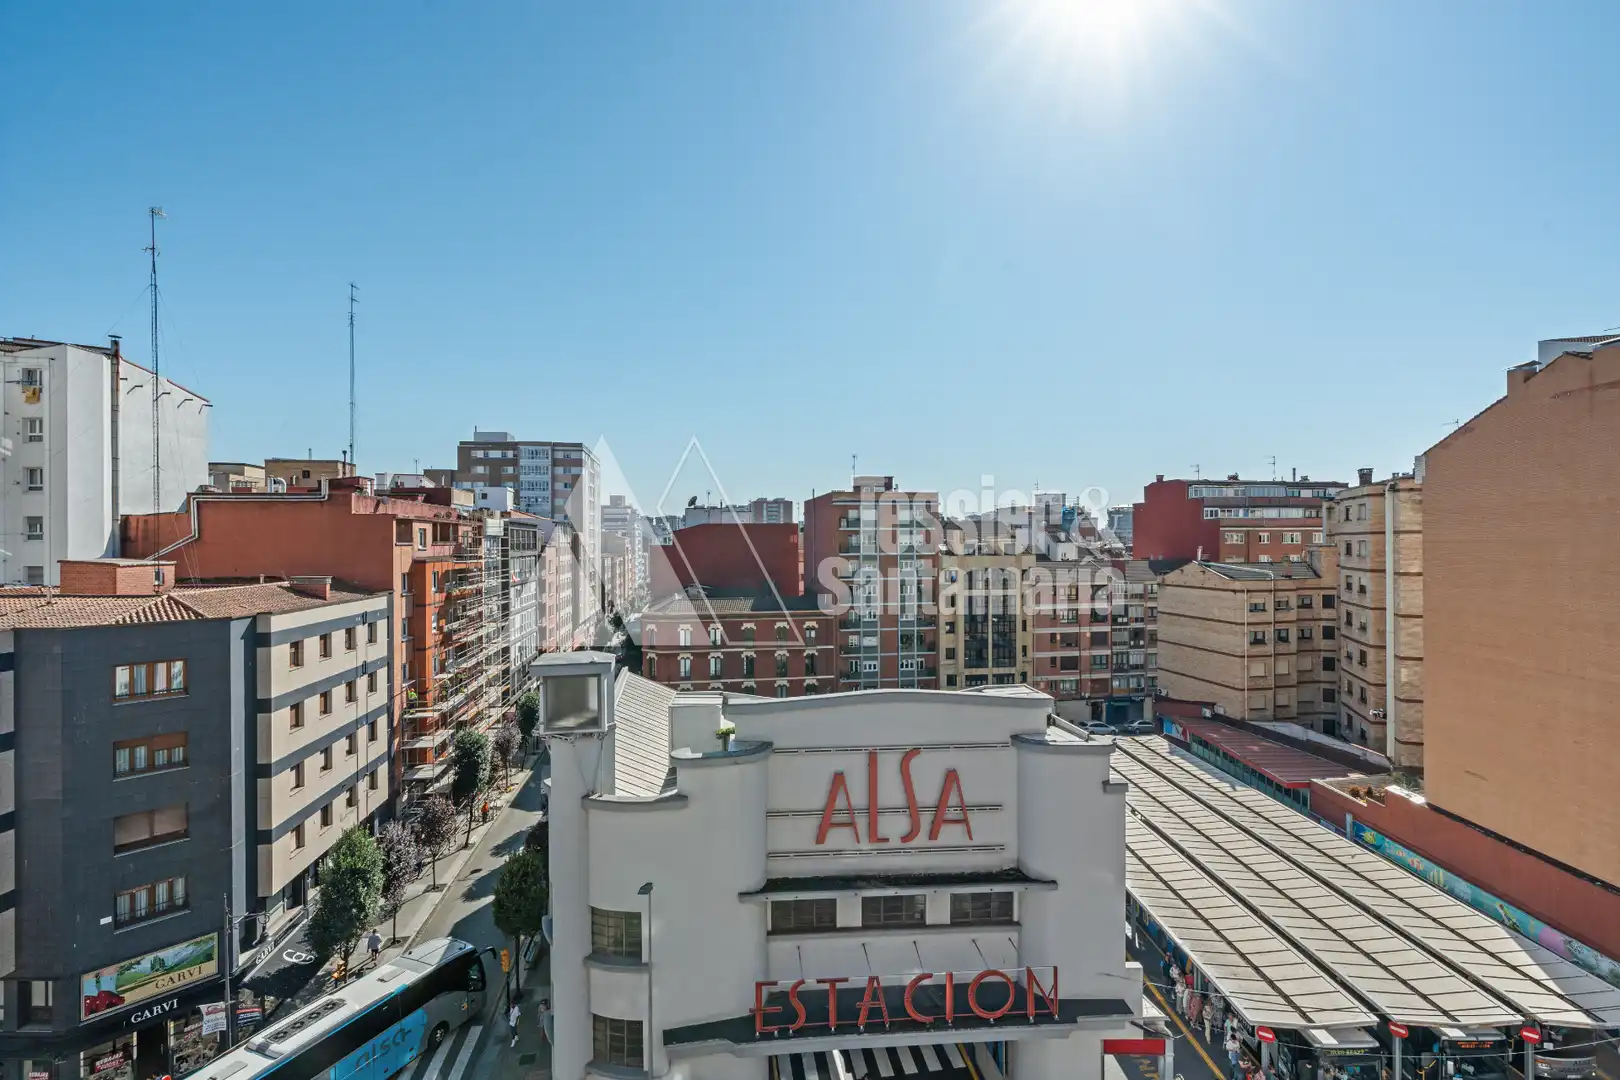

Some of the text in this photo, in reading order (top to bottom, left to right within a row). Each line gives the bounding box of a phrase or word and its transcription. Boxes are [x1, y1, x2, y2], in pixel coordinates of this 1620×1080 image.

[815, 748, 974, 845] ALSA
[155, 965, 203, 990] GARVI
[749, 965, 1060, 1034] ESTACION
[130, 998, 179, 1024] GARVI
[354, 1028, 413, 1073] alsa
